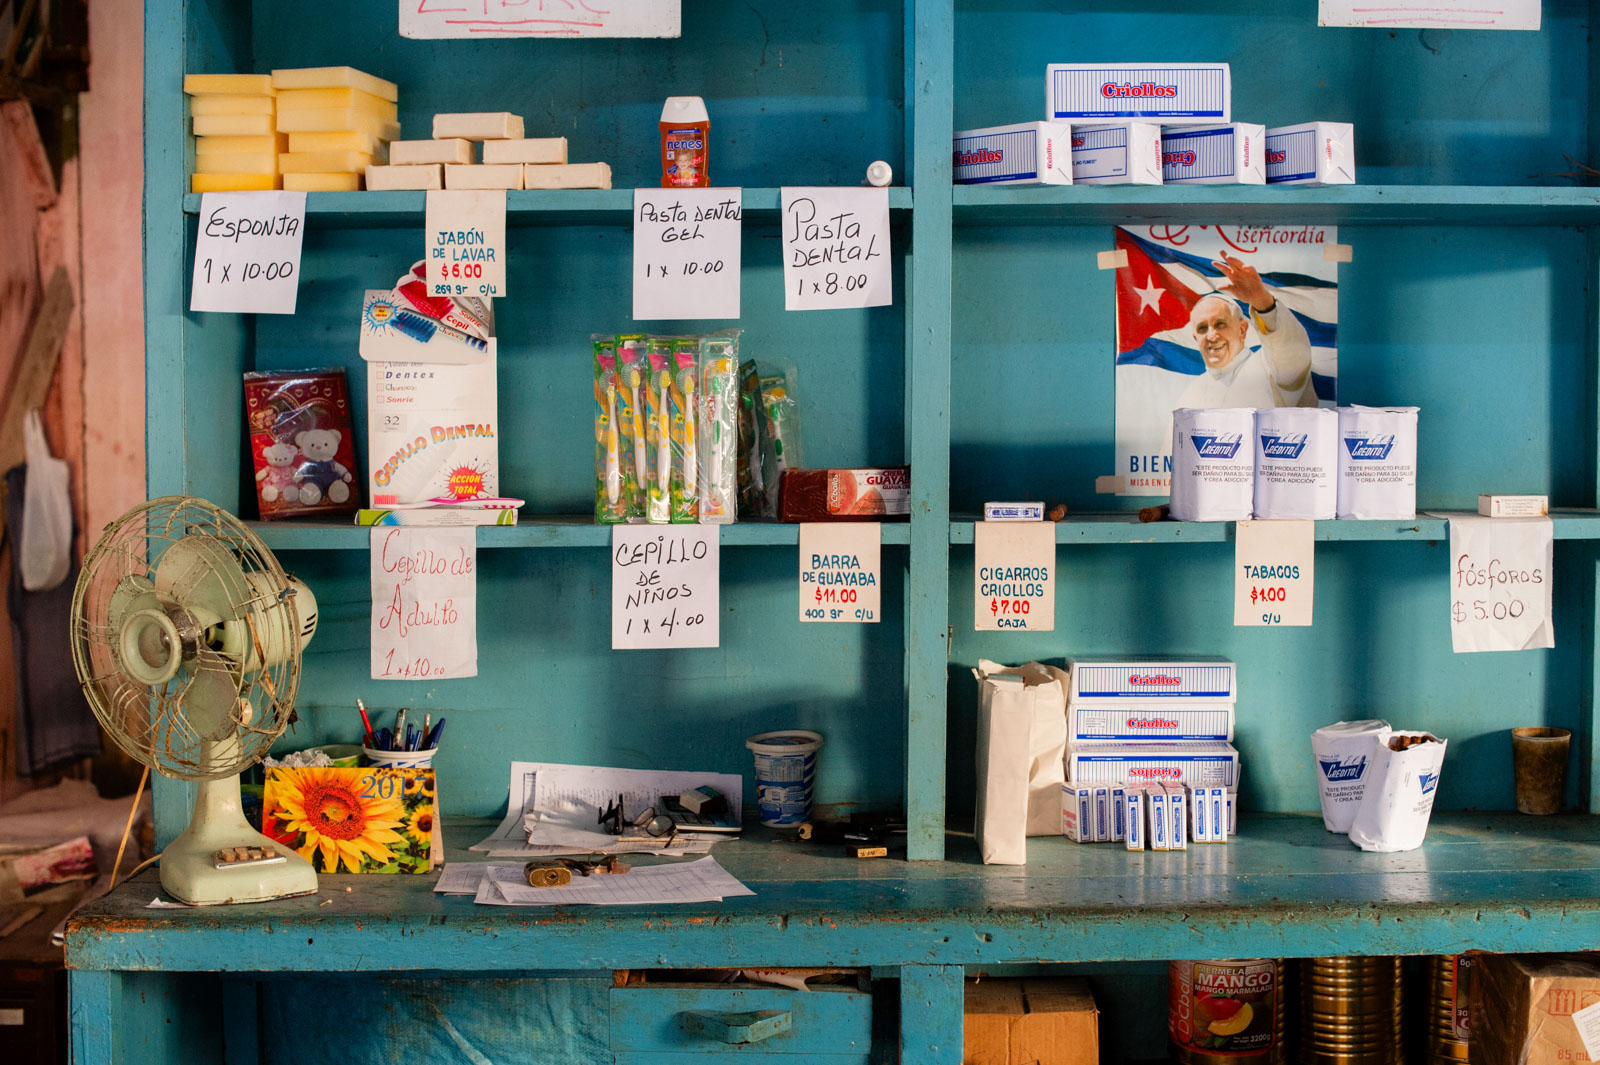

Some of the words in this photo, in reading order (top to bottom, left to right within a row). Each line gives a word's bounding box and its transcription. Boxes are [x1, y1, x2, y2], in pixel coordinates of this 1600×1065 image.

[1102, 82, 1177, 98] Criollos
[667, 140, 703, 149] nenes
[437, 227, 484, 246] JABÓN
[661, 224, 704, 242] GEL
[433, 248, 445, 258] DE
[453, 248, 495, 262] LAVAR
[204, 258, 212, 283] 1
[242, 261, 293, 282] 10.00
[646, 264, 651, 277] 1
[683, 260, 723, 276] 10.00
[456, 284, 468, 295] gr
[479, 283, 497, 296] c/u
[798, 279, 803, 295] 1
[825, 272, 867, 295] 8.00
[446, 314, 470, 330] Cepil
[385, 371, 434, 379] Dentex
[384, 415, 400, 426] 32
[374, 436, 428, 487] CEPILLO
[430, 424, 494, 444] DENTAL
[1130, 456, 1173, 472] BIEN
[450, 472, 482, 484] ACCIÓN
[454, 485, 478, 494] TOTAL
[382, 528, 447, 585] Cepillo
[451, 547, 472, 575] de
[812, 554, 860, 569] BARRA
[636, 570, 660, 587] DE
[803, 572, 815, 582] DE
[818, 571, 876, 586] GUAYABA
[980, 567, 1048, 581] CIGARROS
[1244, 565, 1300, 579] TABACOS
[815, 586, 857, 605] $11.00
[981, 583, 1044, 597] CRIOLLOS
[380, 583, 458, 638] Adulto
[991, 597, 1030, 616] $7.00
[805, 609, 825, 618] 400
[830, 609, 844, 619] gr
[855, 608, 873, 621] c/u
[1262, 613, 1281, 625] c/u
[626, 618, 632, 634] 1
[661, 608, 704, 637] 4.00
[997, 618, 1027, 628] CAJA
[1129, 675, 1181, 686] Criollos
[1127, 718, 1178, 729] Criollos
[1130, 767, 1182, 779] Criollos
[361, 775, 428, 800] 2017
[1198, 972, 1271, 988] MANGO
[1194, 984, 1225, 995] MANGO
[1226, 984, 1273, 995] MARMALADE
[1250, 1034, 1271, 1043] 3200g
[1557, 1050, 1571, 1060] 85
